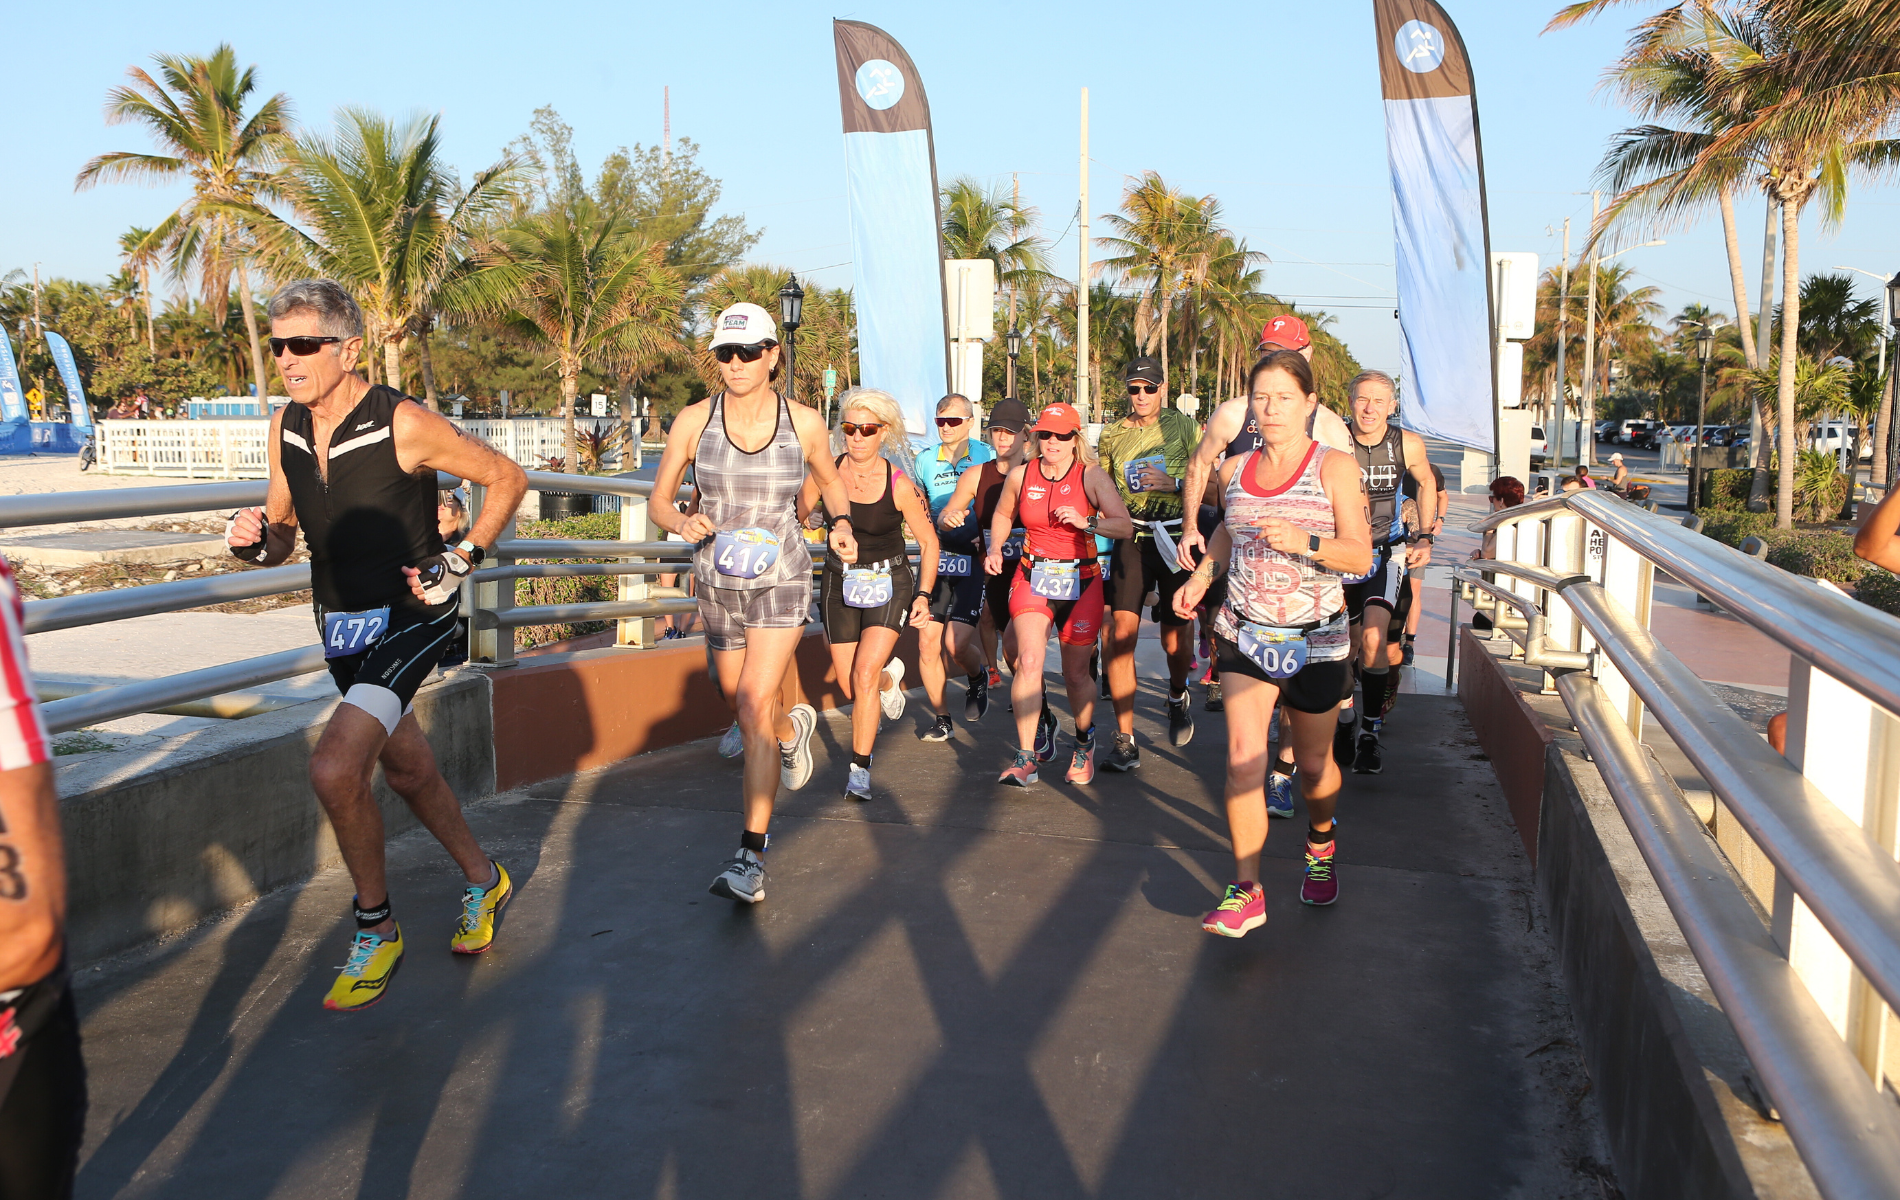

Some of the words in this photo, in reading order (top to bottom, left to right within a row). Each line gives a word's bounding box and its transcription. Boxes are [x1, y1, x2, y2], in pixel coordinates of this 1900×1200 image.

[60, 344, 79, 390] MULTISPORT
[594, 401, 604, 409] 15
[718, 544, 769, 575] 416
[938, 558, 967, 573] 560
[848, 583, 888, 605] 425
[1035, 578, 1075, 597] 437
[330, 616, 383, 650] 472
[1247, 643, 1298, 674] 406
